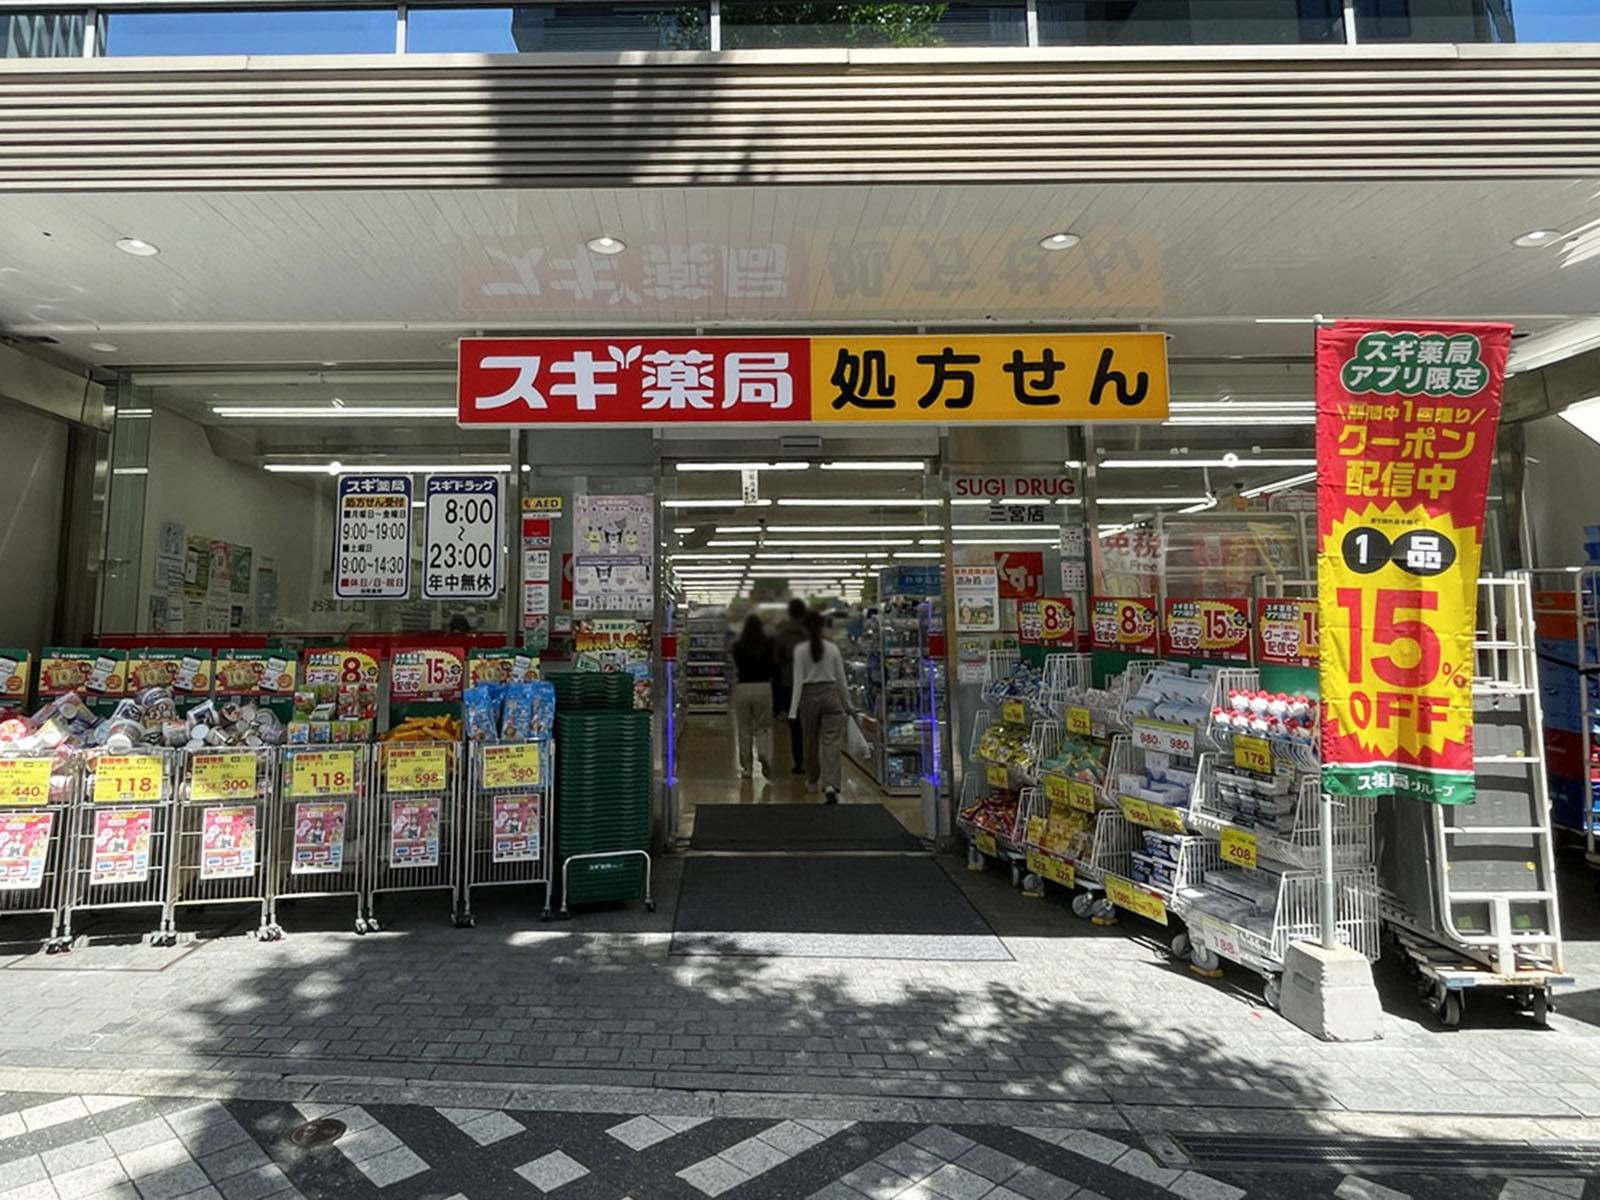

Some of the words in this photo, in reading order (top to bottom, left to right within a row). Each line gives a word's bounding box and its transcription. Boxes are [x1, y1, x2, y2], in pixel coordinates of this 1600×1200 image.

[1364, 340, 1473, 365] スギ薬局
[474, 345, 794, 411] スギ薬局
[831, 346, 1149, 409] 処方せん
[1350, 366, 1482, 391] アプリ限定
[1338, 425, 1477, 459] クーポン
[346, 479, 405, 492] スギ薬局
[429, 479, 496, 492] スギドラッグ
[955, 478, 1006, 496] SUGI
[1015, 478, 1075, 496] DRUG
[1345, 461, 1457, 499] 配信中
[344, 497, 406, 508] 処方せん受付
[535, 499, 559, 508] AED
[445, 499, 493, 524] 8:00
[989, 505, 1045, 522] 三宮店
[350, 544, 373, 552] 土曜日
[1355, 534, 1369, 565] 1
[1407, 535, 1442, 569] 品
[429, 543, 493, 569] 23:00
[428, 574, 492, 591] 年中無休
[1171, 626, 1201, 636] クーポン
[1227, 628, 1245, 639] OFF
[1264, 630, 1300, 642] クーポン
[1336, 587, 1468, 690] 15%
[1173, 637, 1198, 648] 配信中
[1267, 643, 1297, 654] 配信中
[1349, 690, 1450, 735] OFF
[1139, 732, 1158, 745] 980
[1169, 738, 1189, 750] 980
[1243, 751, 1265, 766] 178
[311, 772, 346, 787] 118
[415, 772, 439, 784] 598
[510, 767, 534, 780] 380
[12, 786, 40, 797] 440
[115, 777, 152, 792] 118
[222, 779, 249, 791] 300
[1229, 844, 1251, 861] 208
